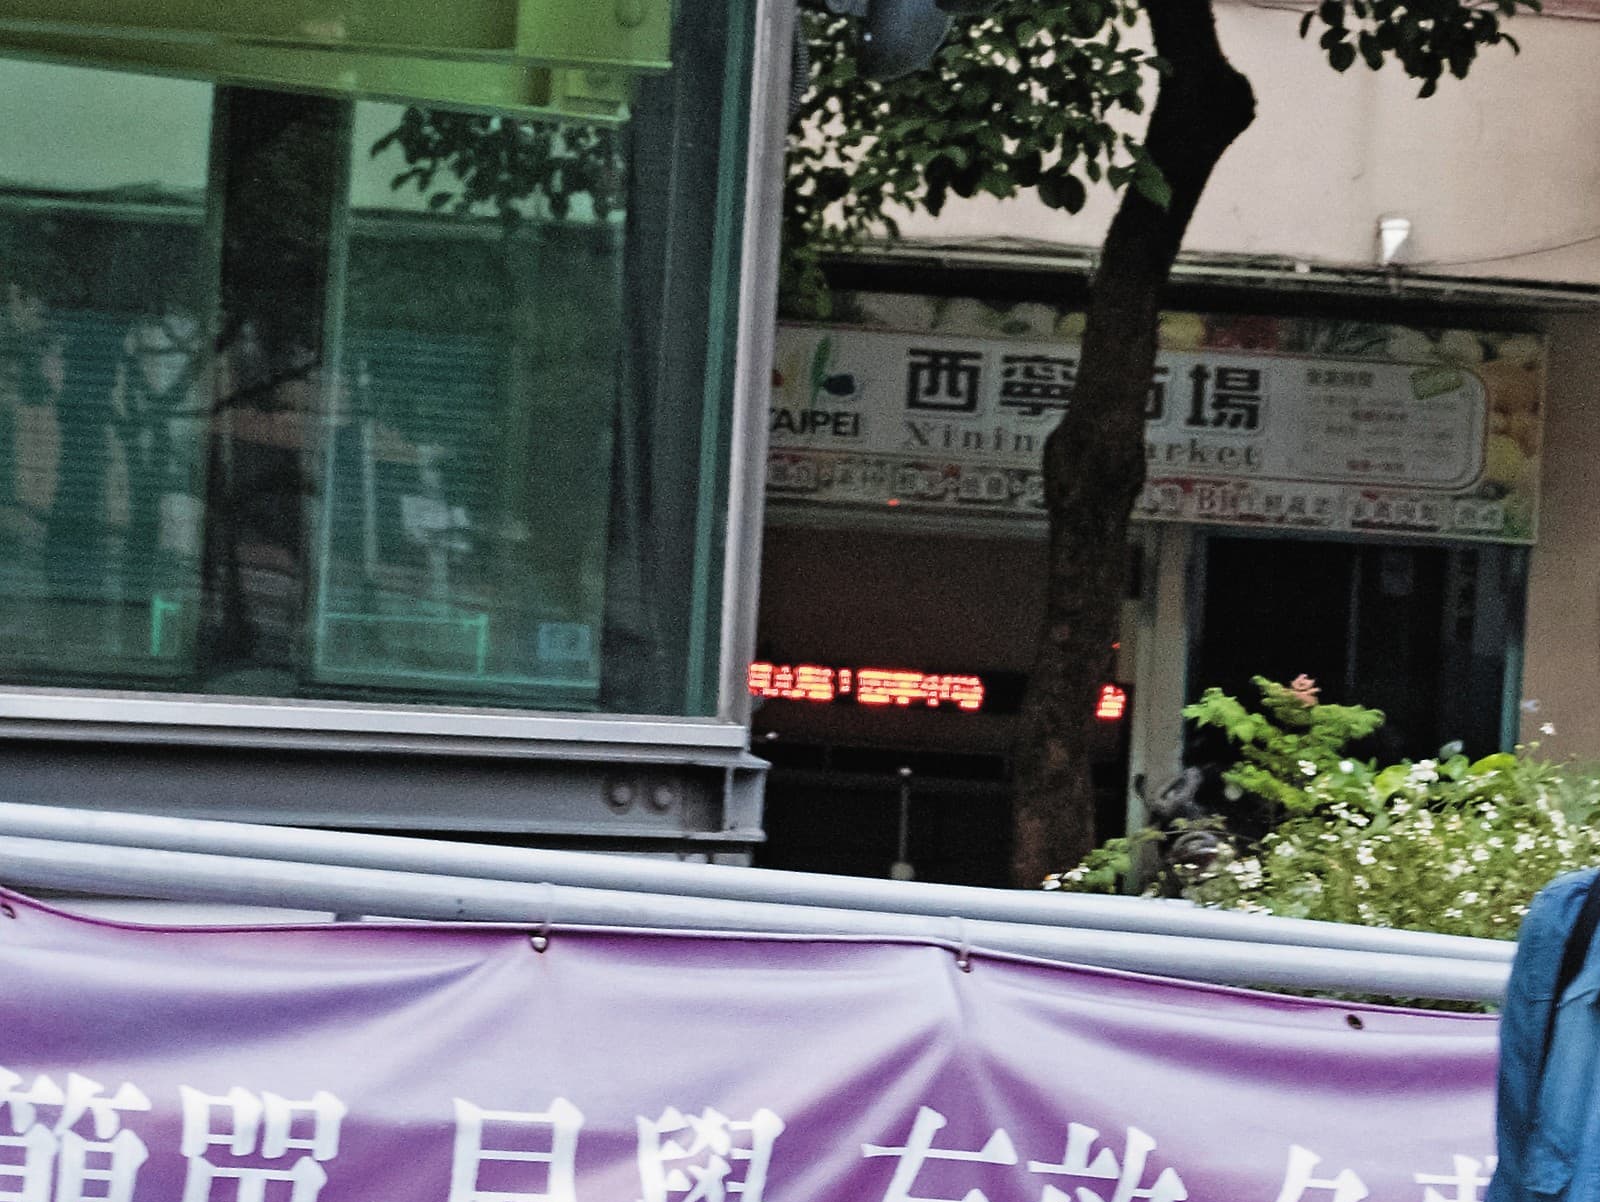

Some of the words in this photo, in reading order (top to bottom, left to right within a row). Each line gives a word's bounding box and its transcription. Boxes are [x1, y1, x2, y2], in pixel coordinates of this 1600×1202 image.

[769, 408, 860, 437] AIPEI
[902, 420, 1035, 452] Xinin
[1145, 437, 1259, 467] arket
